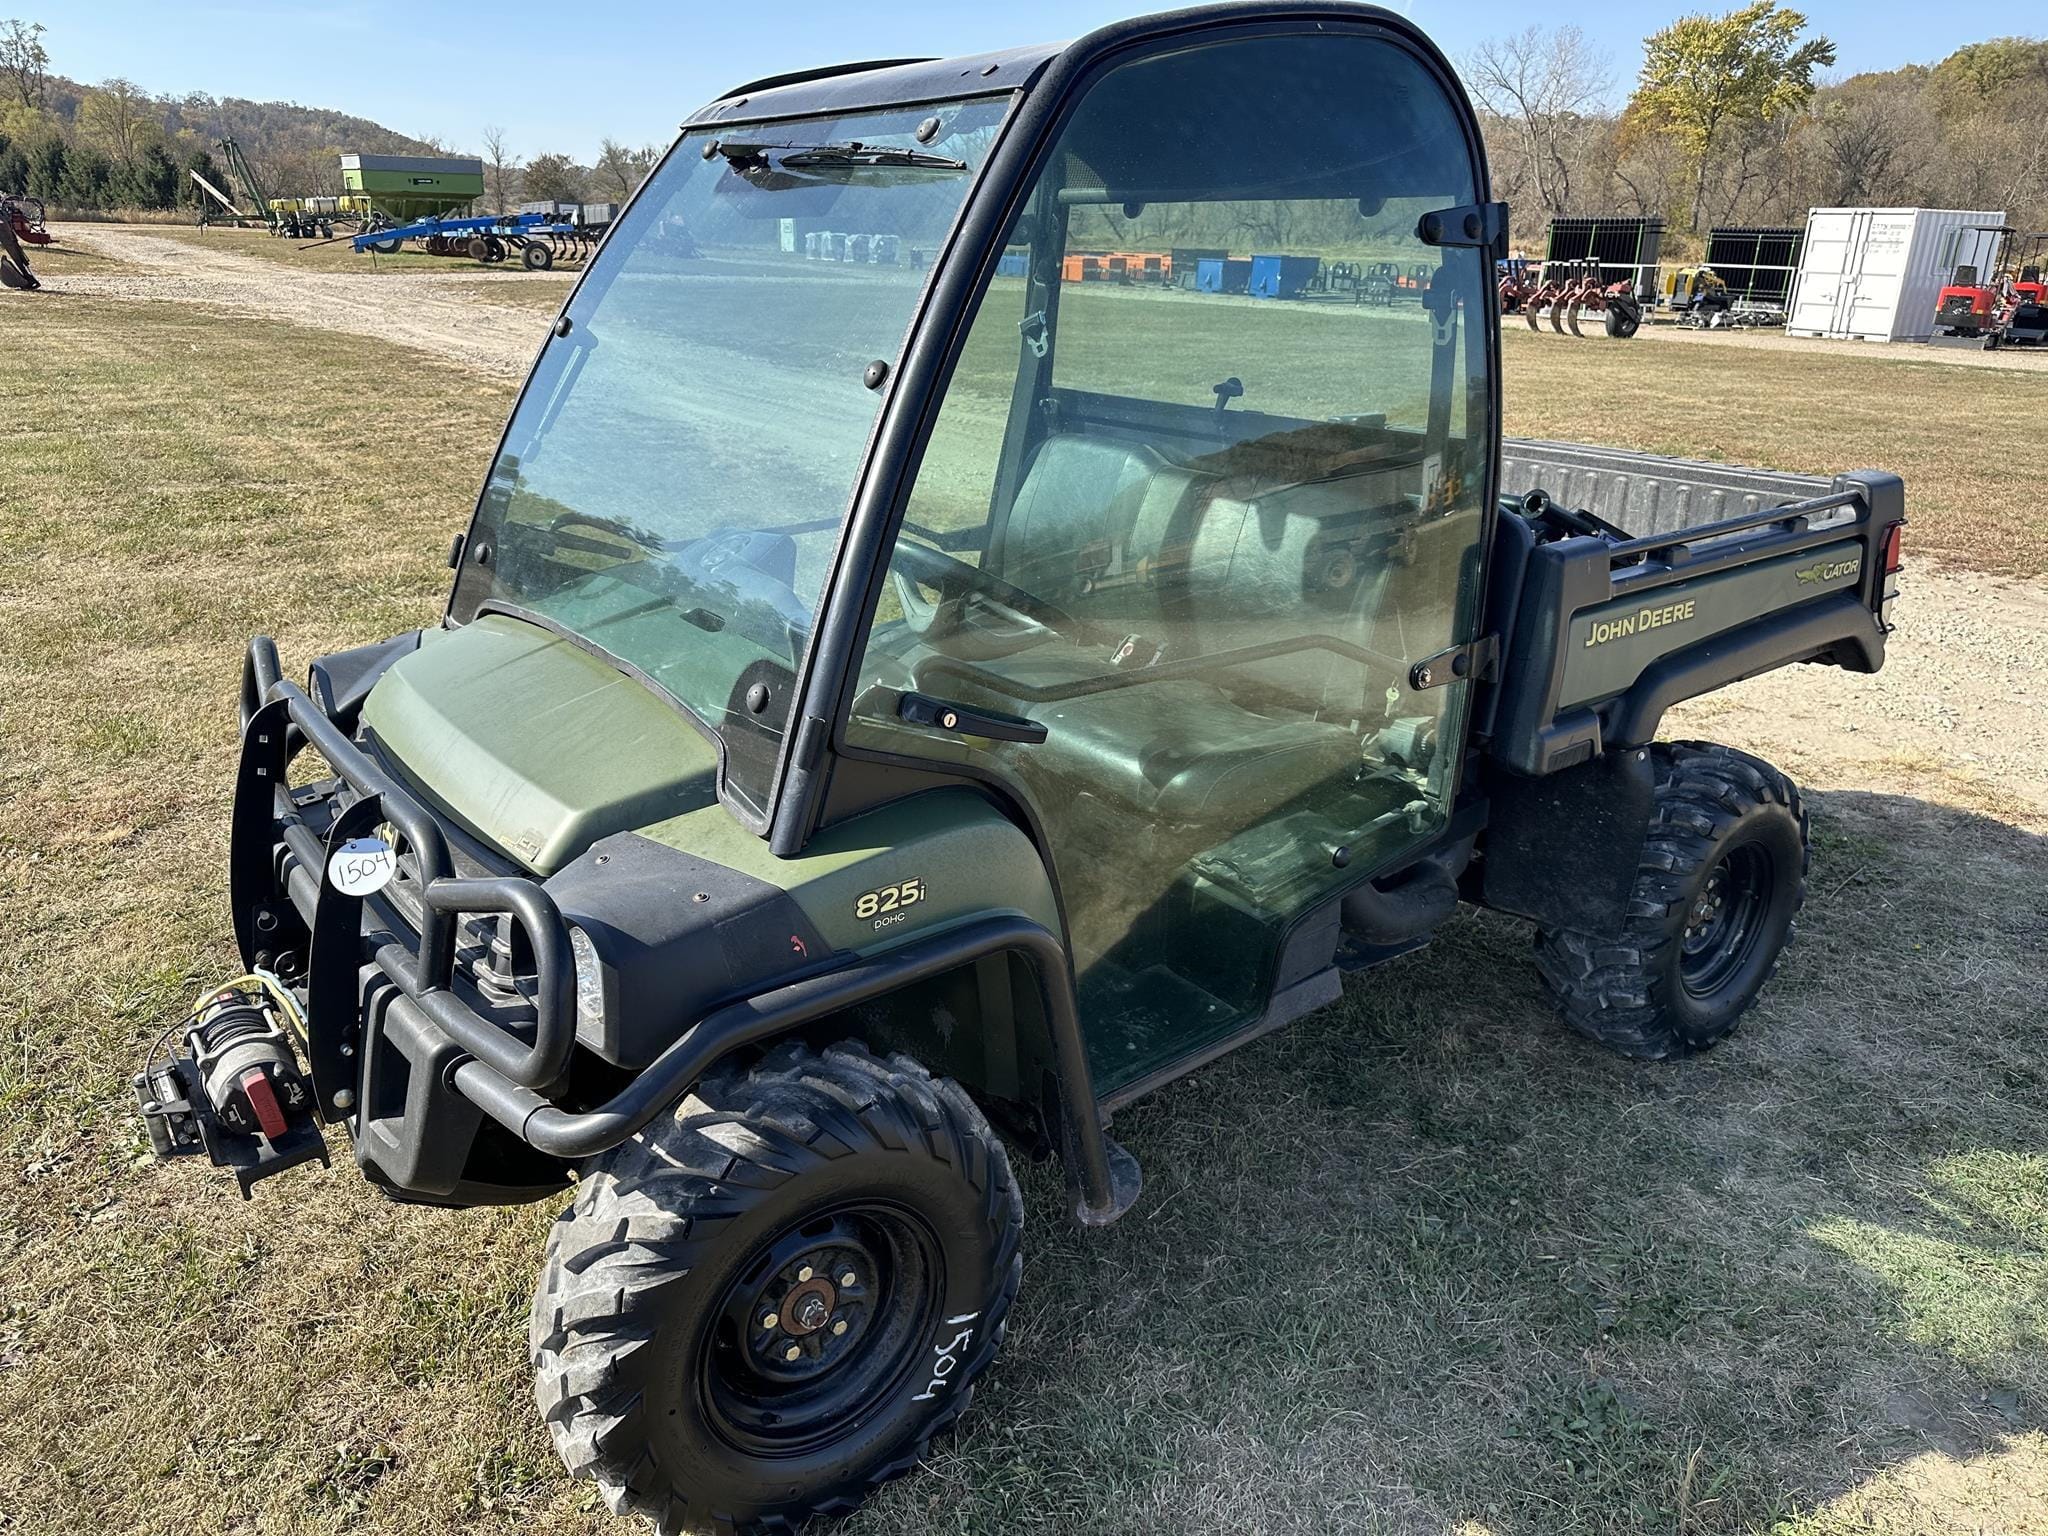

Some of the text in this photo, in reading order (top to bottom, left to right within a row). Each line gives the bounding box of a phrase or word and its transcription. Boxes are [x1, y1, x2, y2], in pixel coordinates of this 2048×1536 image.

[1823, 559, 1859, 581] GATOR
[1585, 600, 1696, 648] JOHN DEERE
[338, 847, 391, 887] 1504
[855, 879, 926, 919] 825i
[874, 912, 906, 930] DOHC
[911, 1310, 981, 1401] 1504
